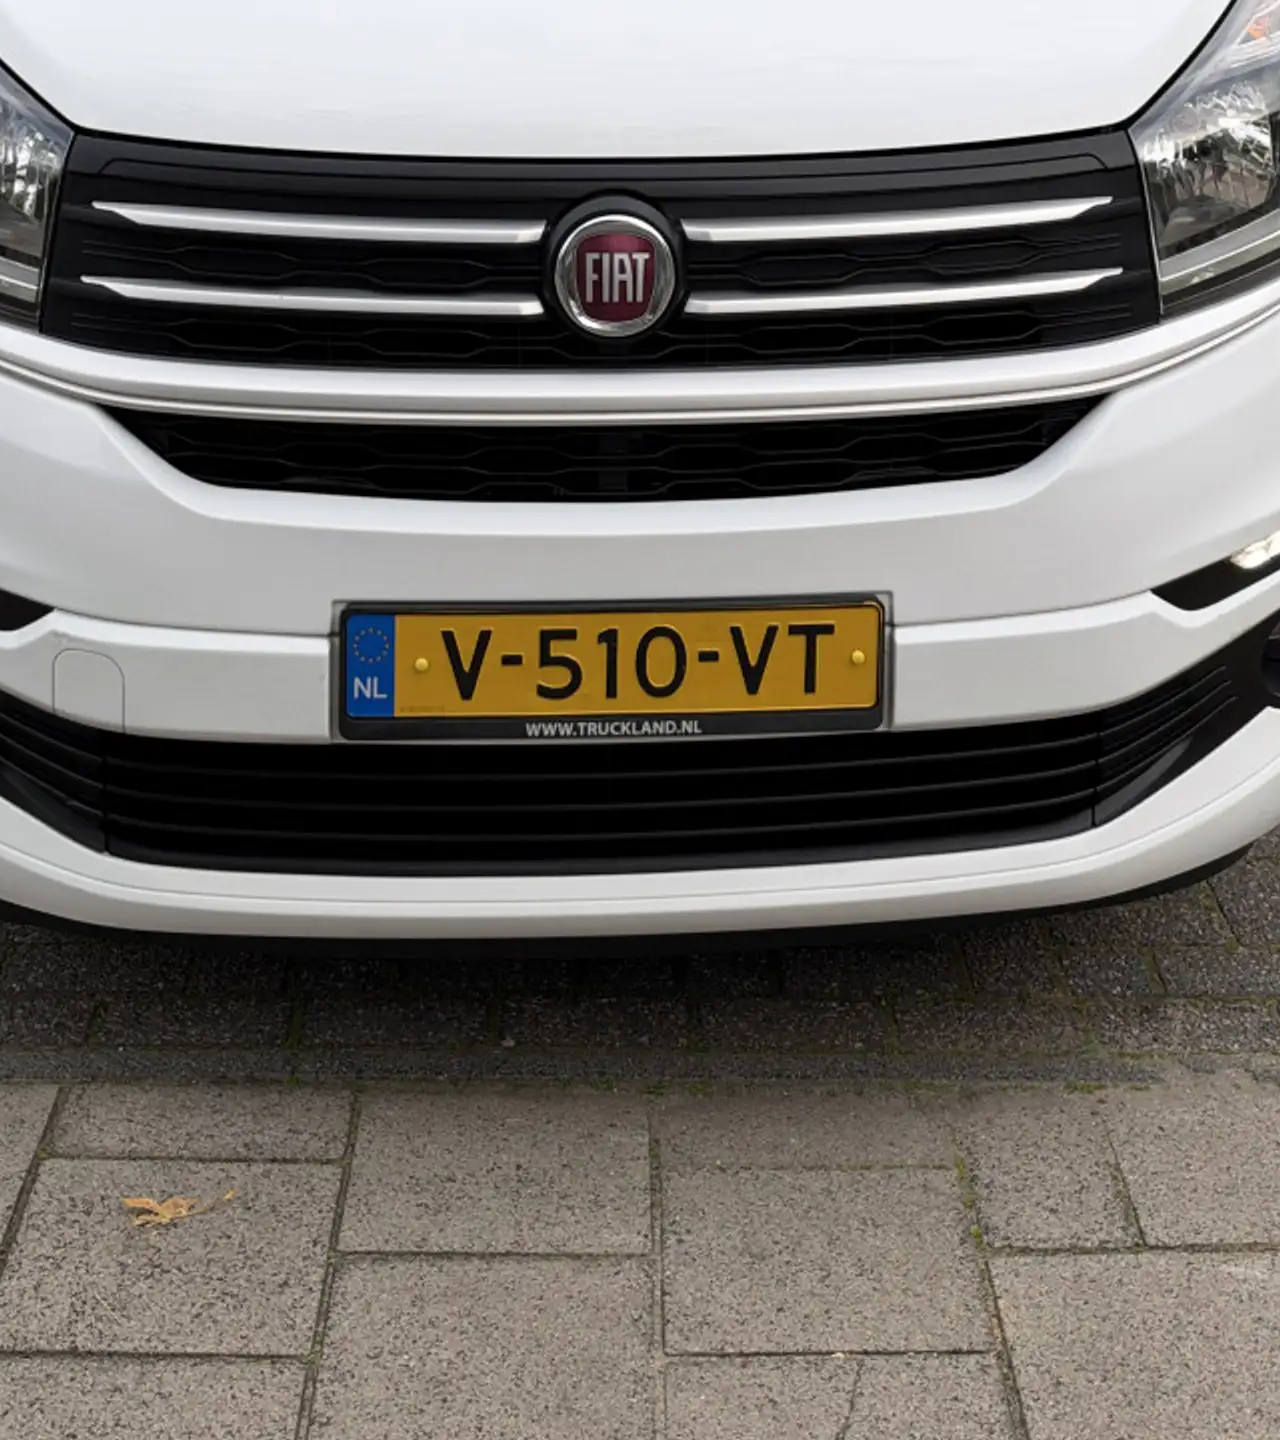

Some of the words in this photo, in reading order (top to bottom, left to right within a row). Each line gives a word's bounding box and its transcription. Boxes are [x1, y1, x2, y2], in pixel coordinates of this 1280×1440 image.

[584, 252, 651, 304] FIAT
[440, 623, 836, 702] V-510-VT
[352, 676, 389, 700] NL
[525, 719, 703, 738] WWW.TRUCKLAND.NL
